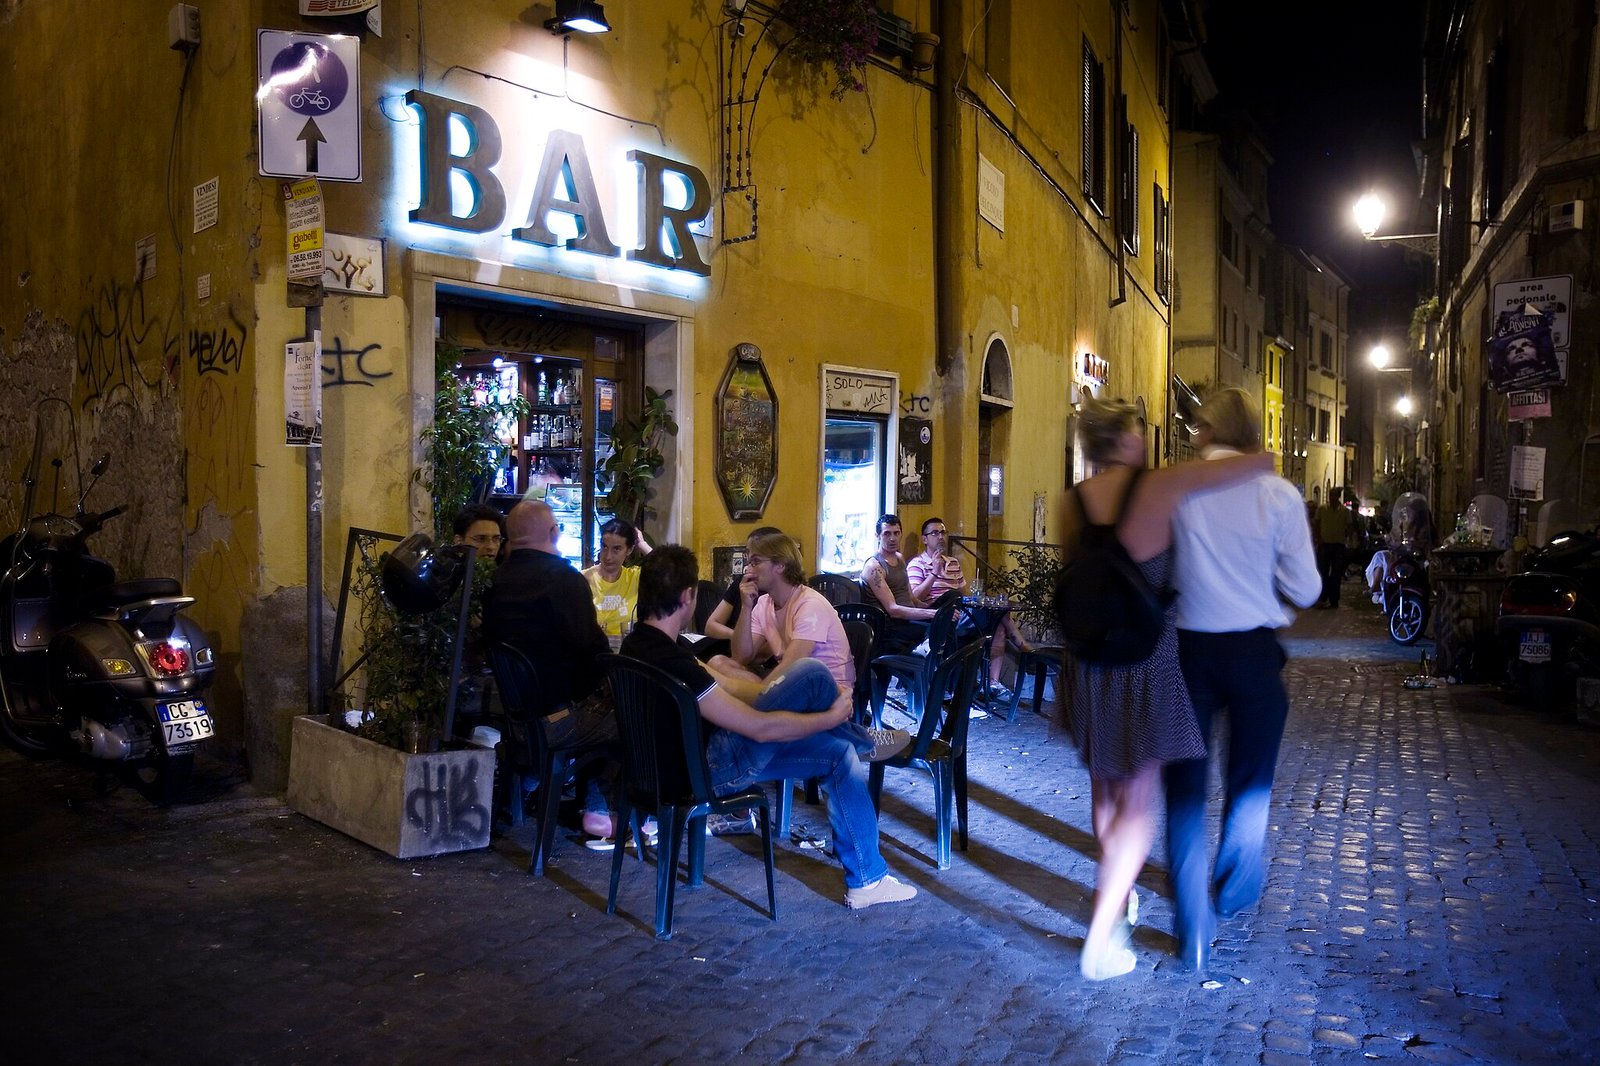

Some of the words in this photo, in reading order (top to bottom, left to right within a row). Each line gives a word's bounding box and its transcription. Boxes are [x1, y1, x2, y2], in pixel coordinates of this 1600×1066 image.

[405, 89, 711, 277] BAR
[1519, 284, 1543, 292] area
[1506, 294, 1556, 306] pedonale
[833, 376, 863, 390] SOLO
[1511, 391, 1546, 406] AFFITTASI
[168, 703, 189, 719] CG
[165, 718, 211, 742] 73519
